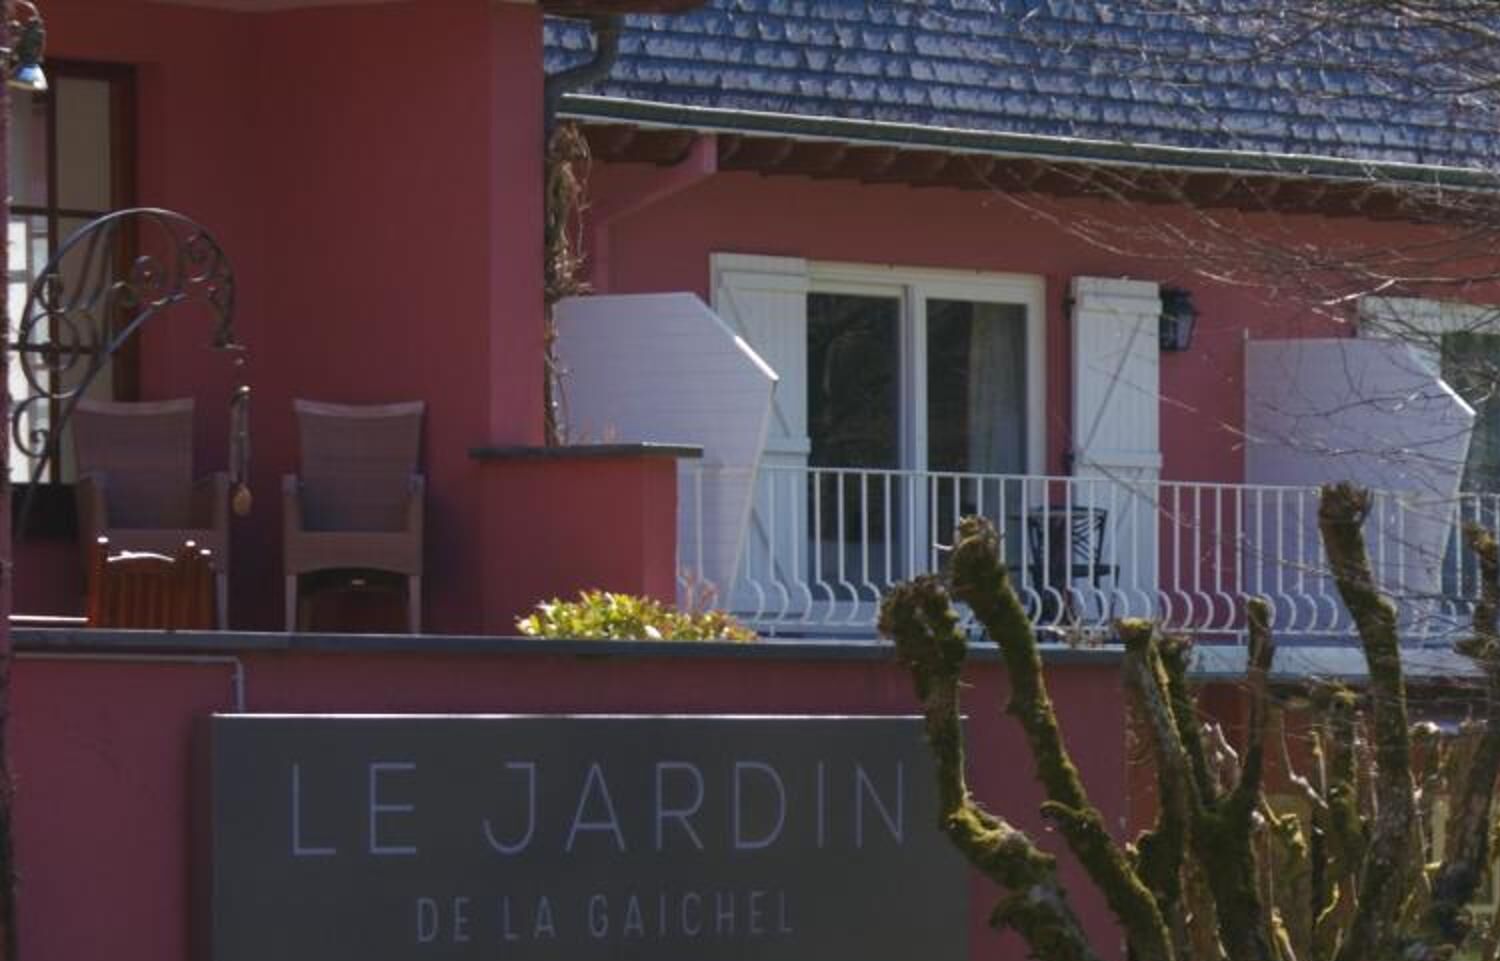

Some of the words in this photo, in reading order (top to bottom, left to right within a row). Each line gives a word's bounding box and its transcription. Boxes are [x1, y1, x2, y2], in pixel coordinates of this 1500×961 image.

[291, 761, 417, 856] LE
[482, 761, 906, 853] JARDIN
[415, 895, 471, 943] DE
[502, 893, 556, 941] LA
[587, 889, 796, 938] GAICHEL
